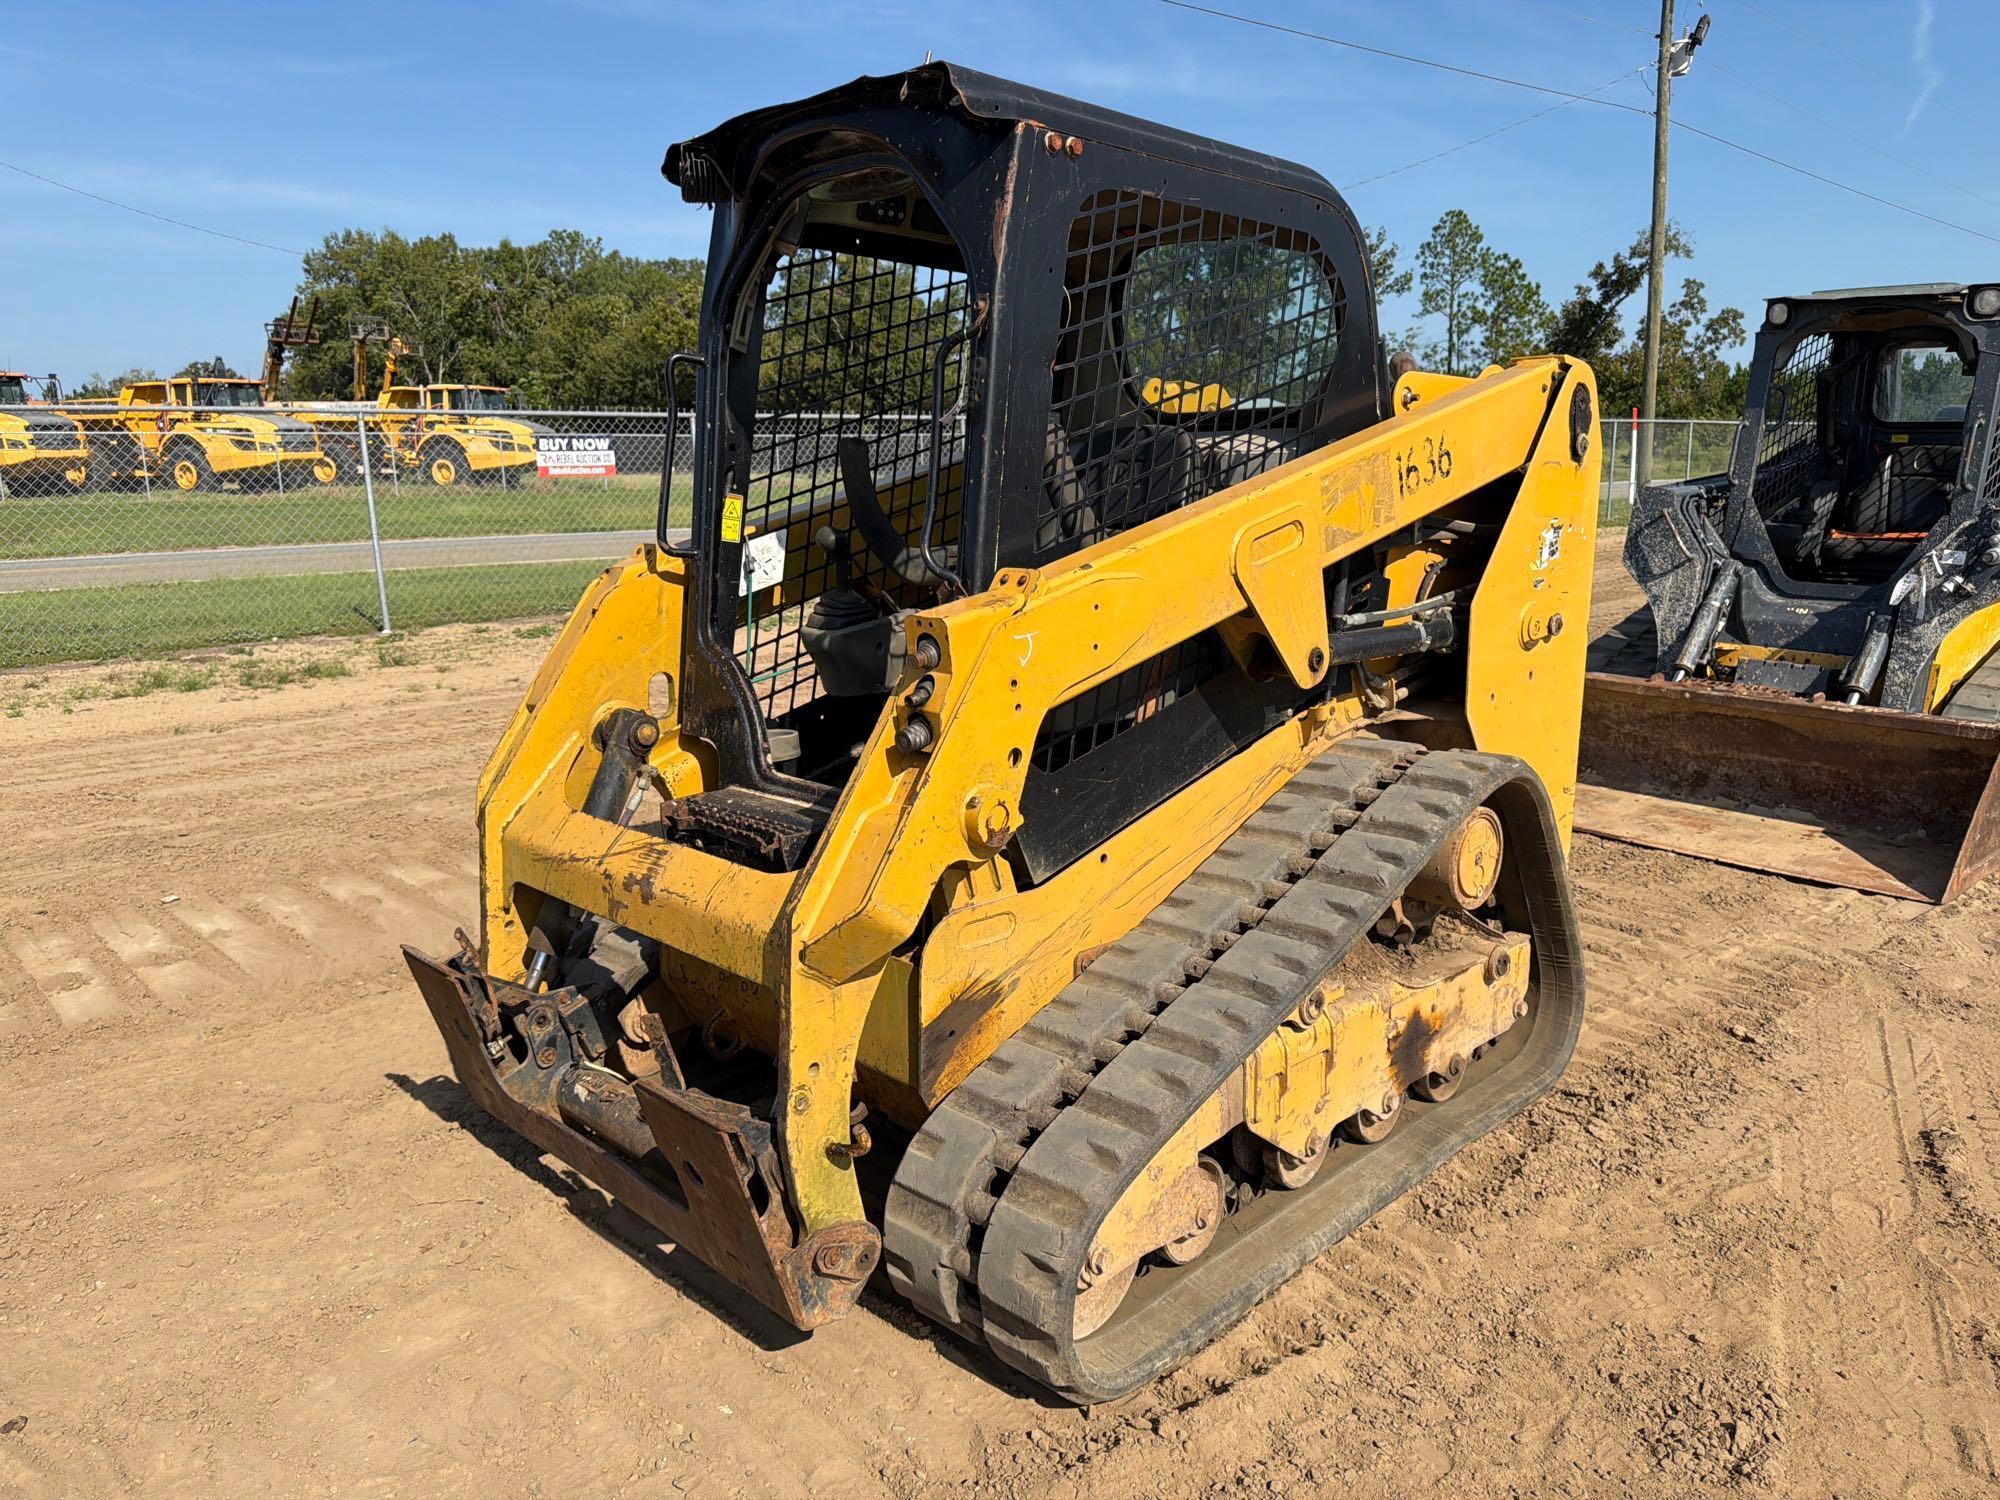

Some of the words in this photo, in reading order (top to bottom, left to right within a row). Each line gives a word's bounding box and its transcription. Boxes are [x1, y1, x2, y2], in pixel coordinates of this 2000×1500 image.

[538, 437, 568, 450] BUY
[572, 437, 609, 450] NOW
[1396, 430, 1452, 500] 1636
